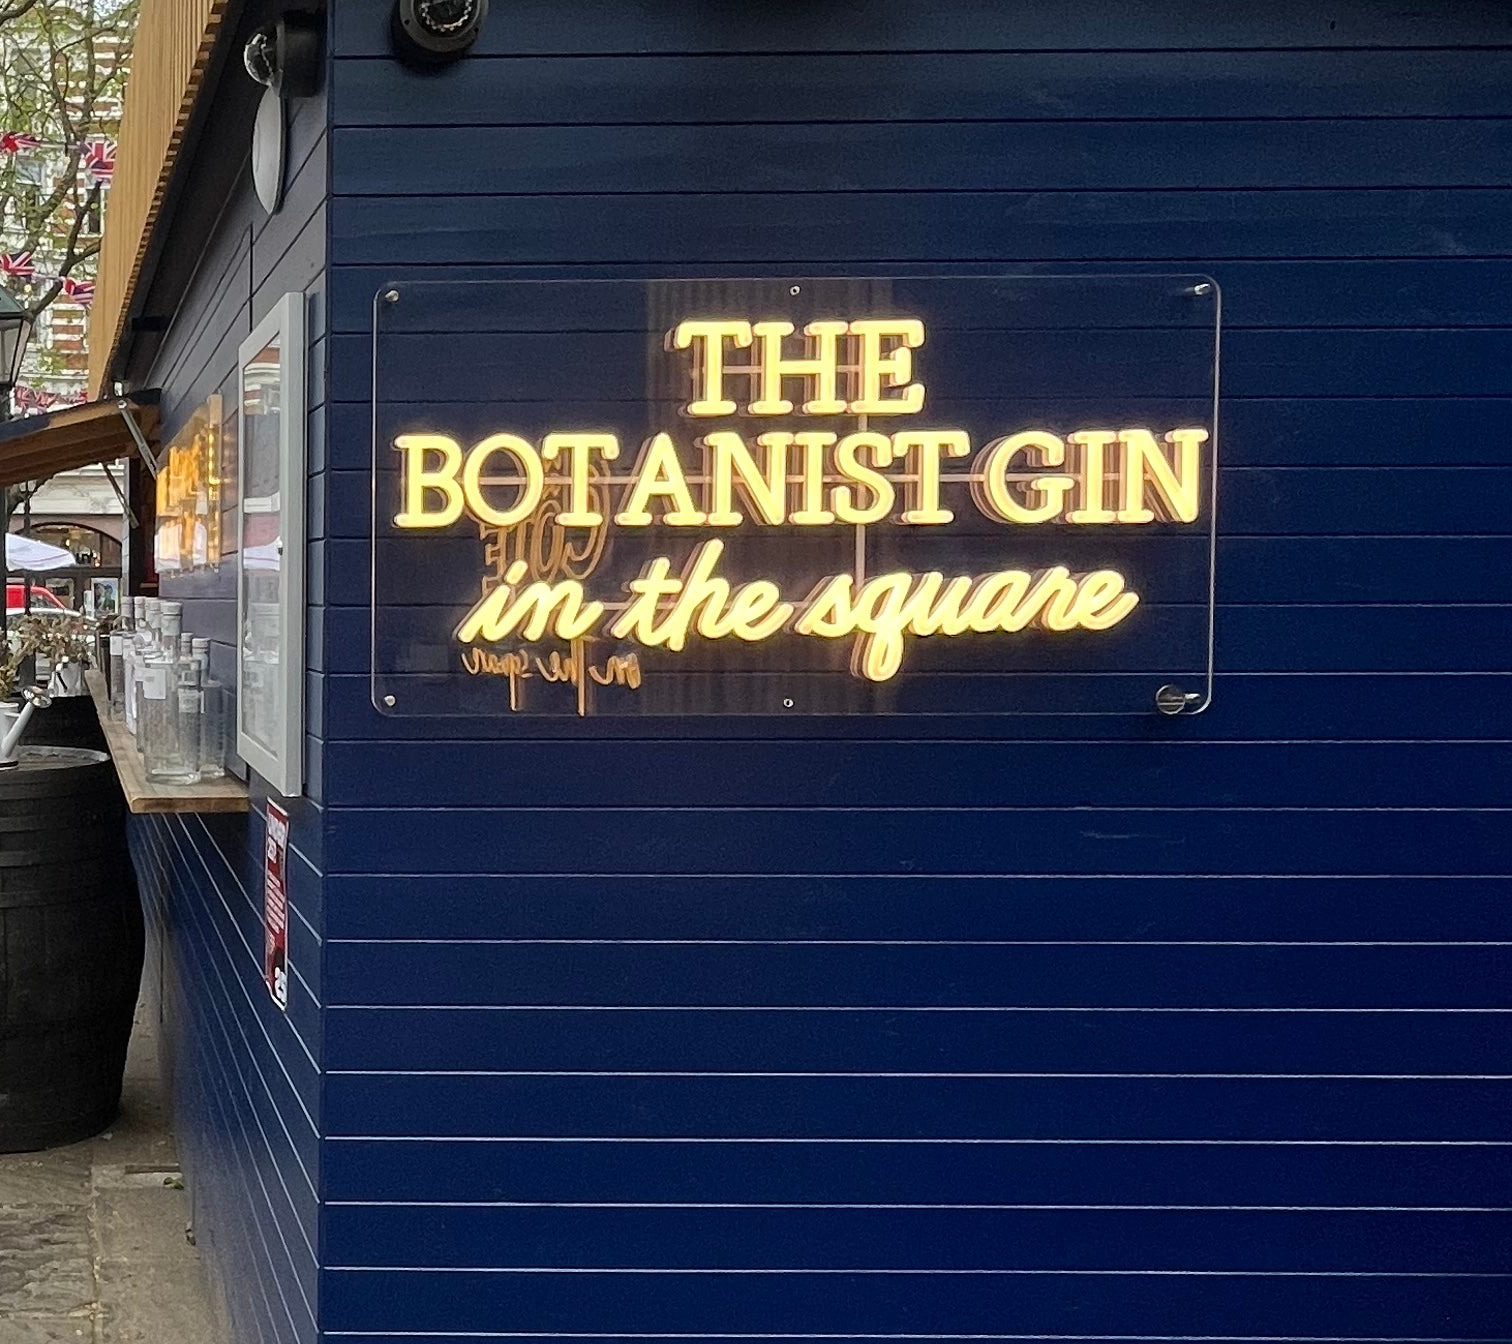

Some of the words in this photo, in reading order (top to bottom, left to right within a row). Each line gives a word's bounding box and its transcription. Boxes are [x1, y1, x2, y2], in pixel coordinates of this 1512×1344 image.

[674, 318, 926, 416] THE
[394, 430, 971, 529] BOTANIST
[976, 429, 1209, 526] GIN
[459, 559, 606, 645] in
[610, 538, 791, 653] the
[794, 567, 1141, 682] square
